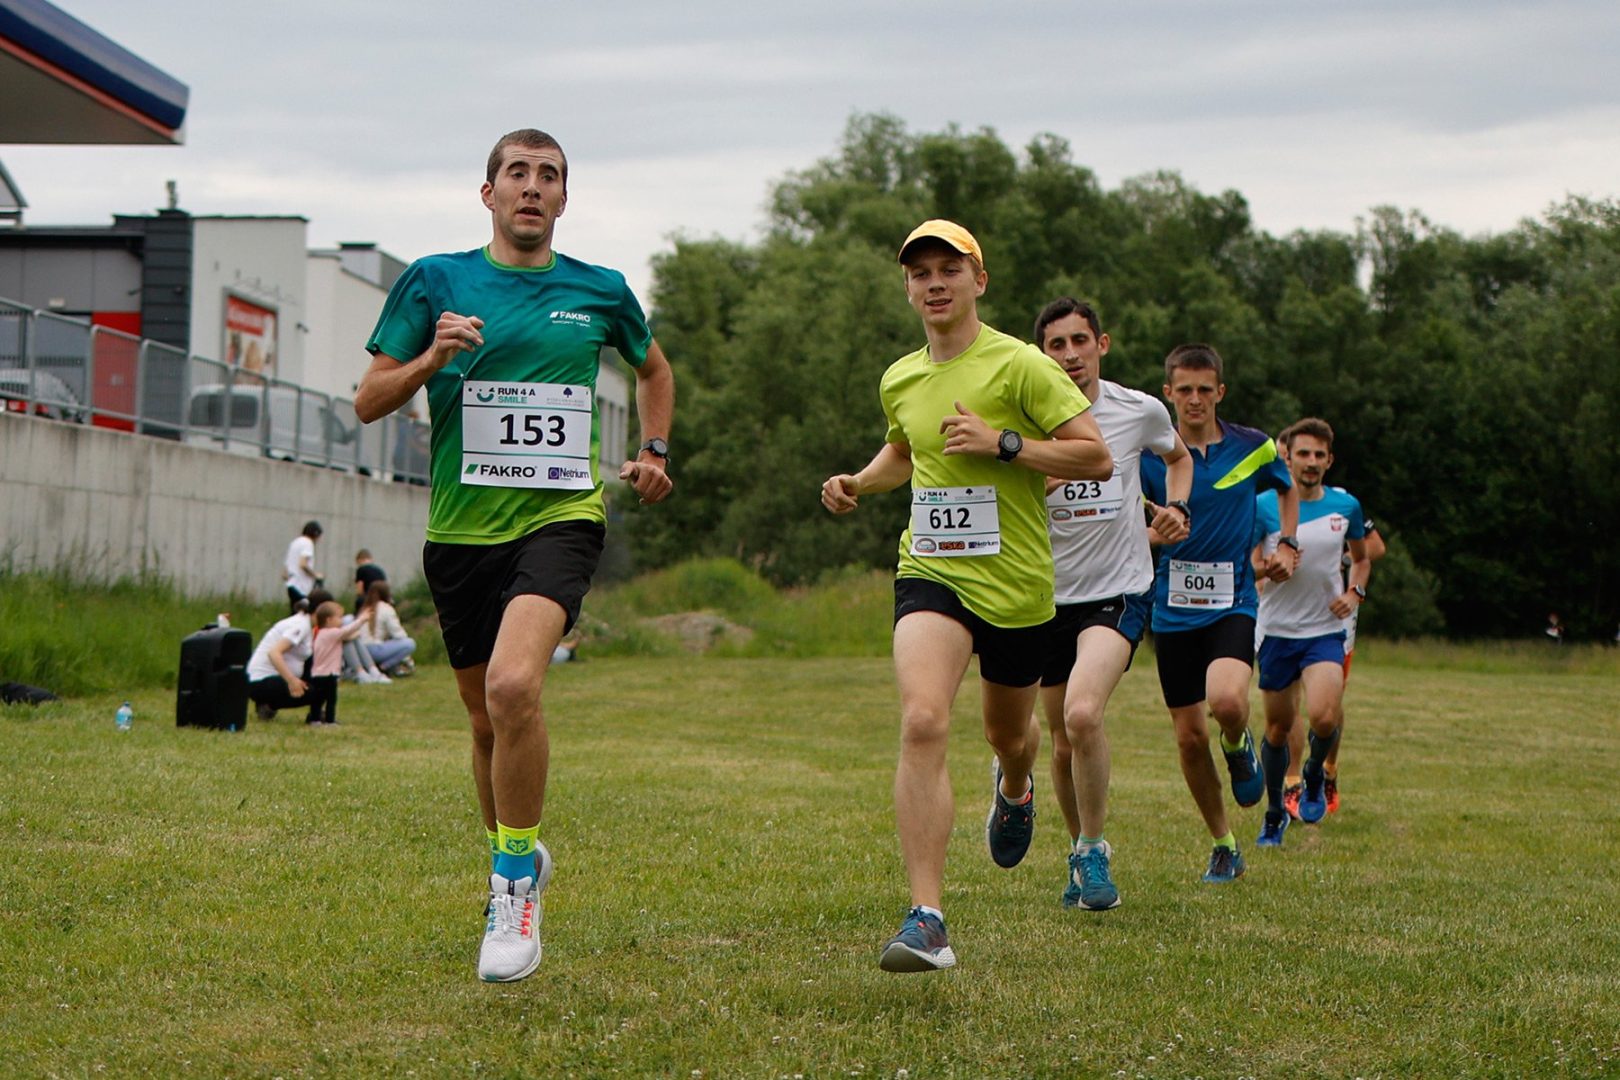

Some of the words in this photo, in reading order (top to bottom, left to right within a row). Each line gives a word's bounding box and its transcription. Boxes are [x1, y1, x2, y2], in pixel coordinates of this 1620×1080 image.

[560, 311, 591, 322] FAKRO
[498, 388, 518, 396] RUN
[520, 388, 527, 396] 4
[498, 396, 527, 404] SMILE
[500, 414, 566, 447] 153
[480, 464, 536, 478] FAKRO
[560, 467, 589, 479] Netrium
[1064, 481, 1102, 501] 623
[930, 507, 972, 530] 612
[1184, 575, 1216, 591] 604
